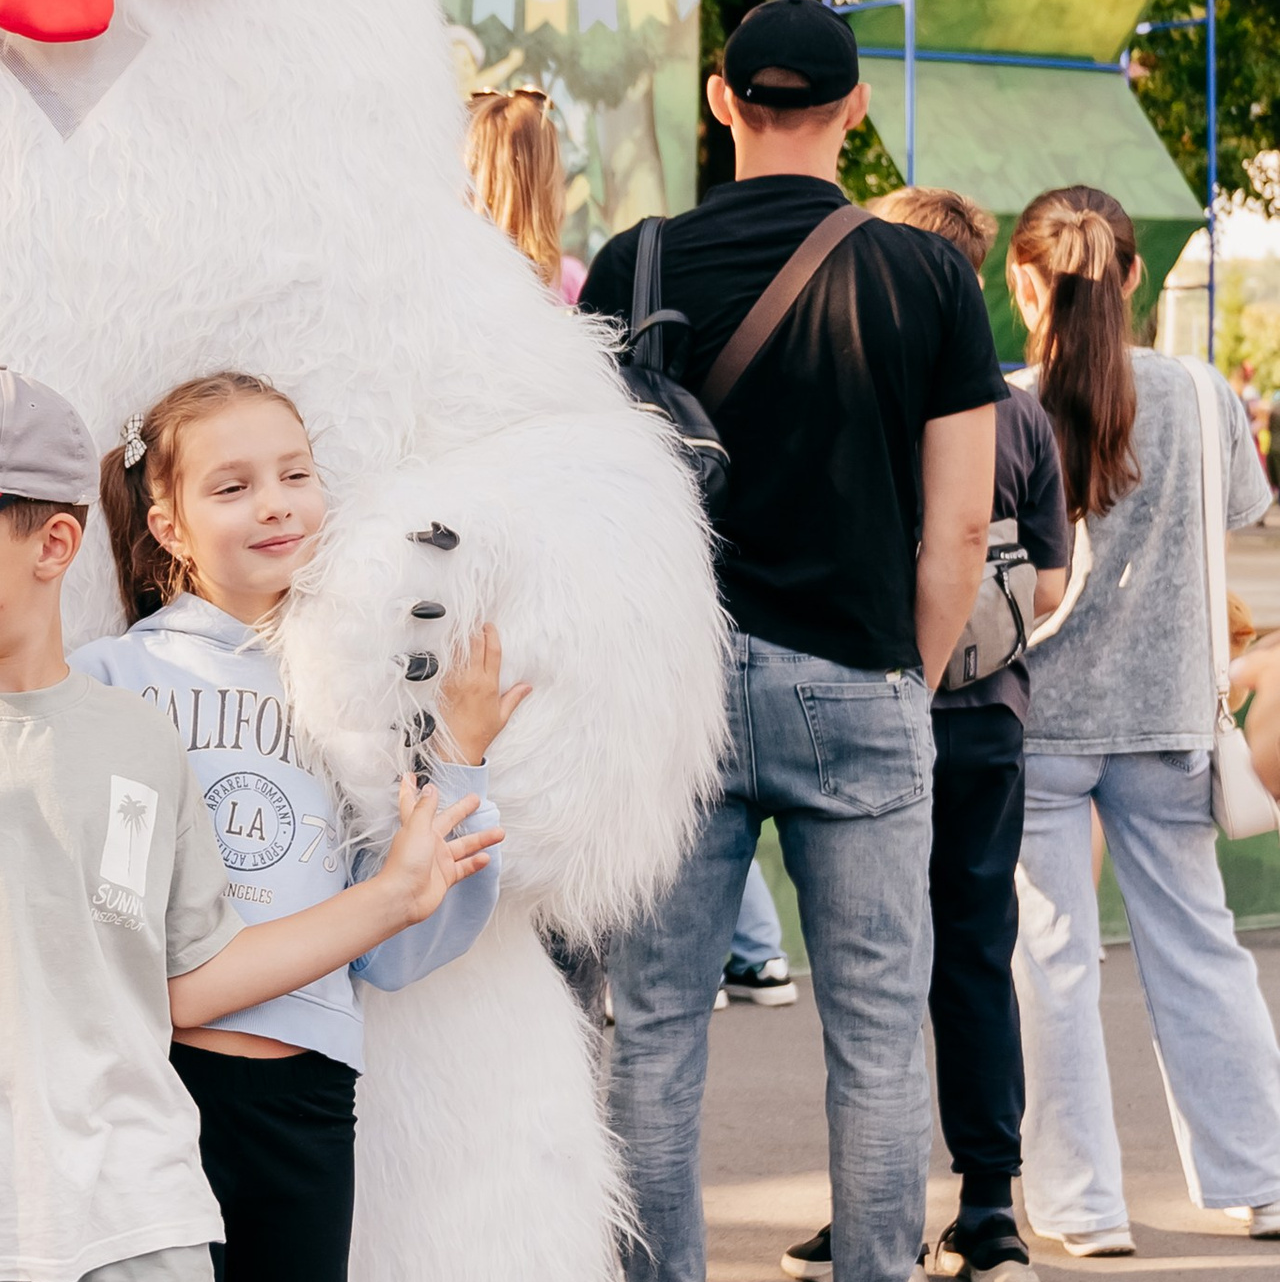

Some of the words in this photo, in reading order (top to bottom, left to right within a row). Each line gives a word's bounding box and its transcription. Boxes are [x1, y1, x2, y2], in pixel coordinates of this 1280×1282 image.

[205, 775, 249, 811] APPAREL
[254, 778, 292, 827] COMPANY
[225, 800, 266, 842] LA
[251, 841, 285, 867] SPORT
[124, 918, 146, 932] OUT
